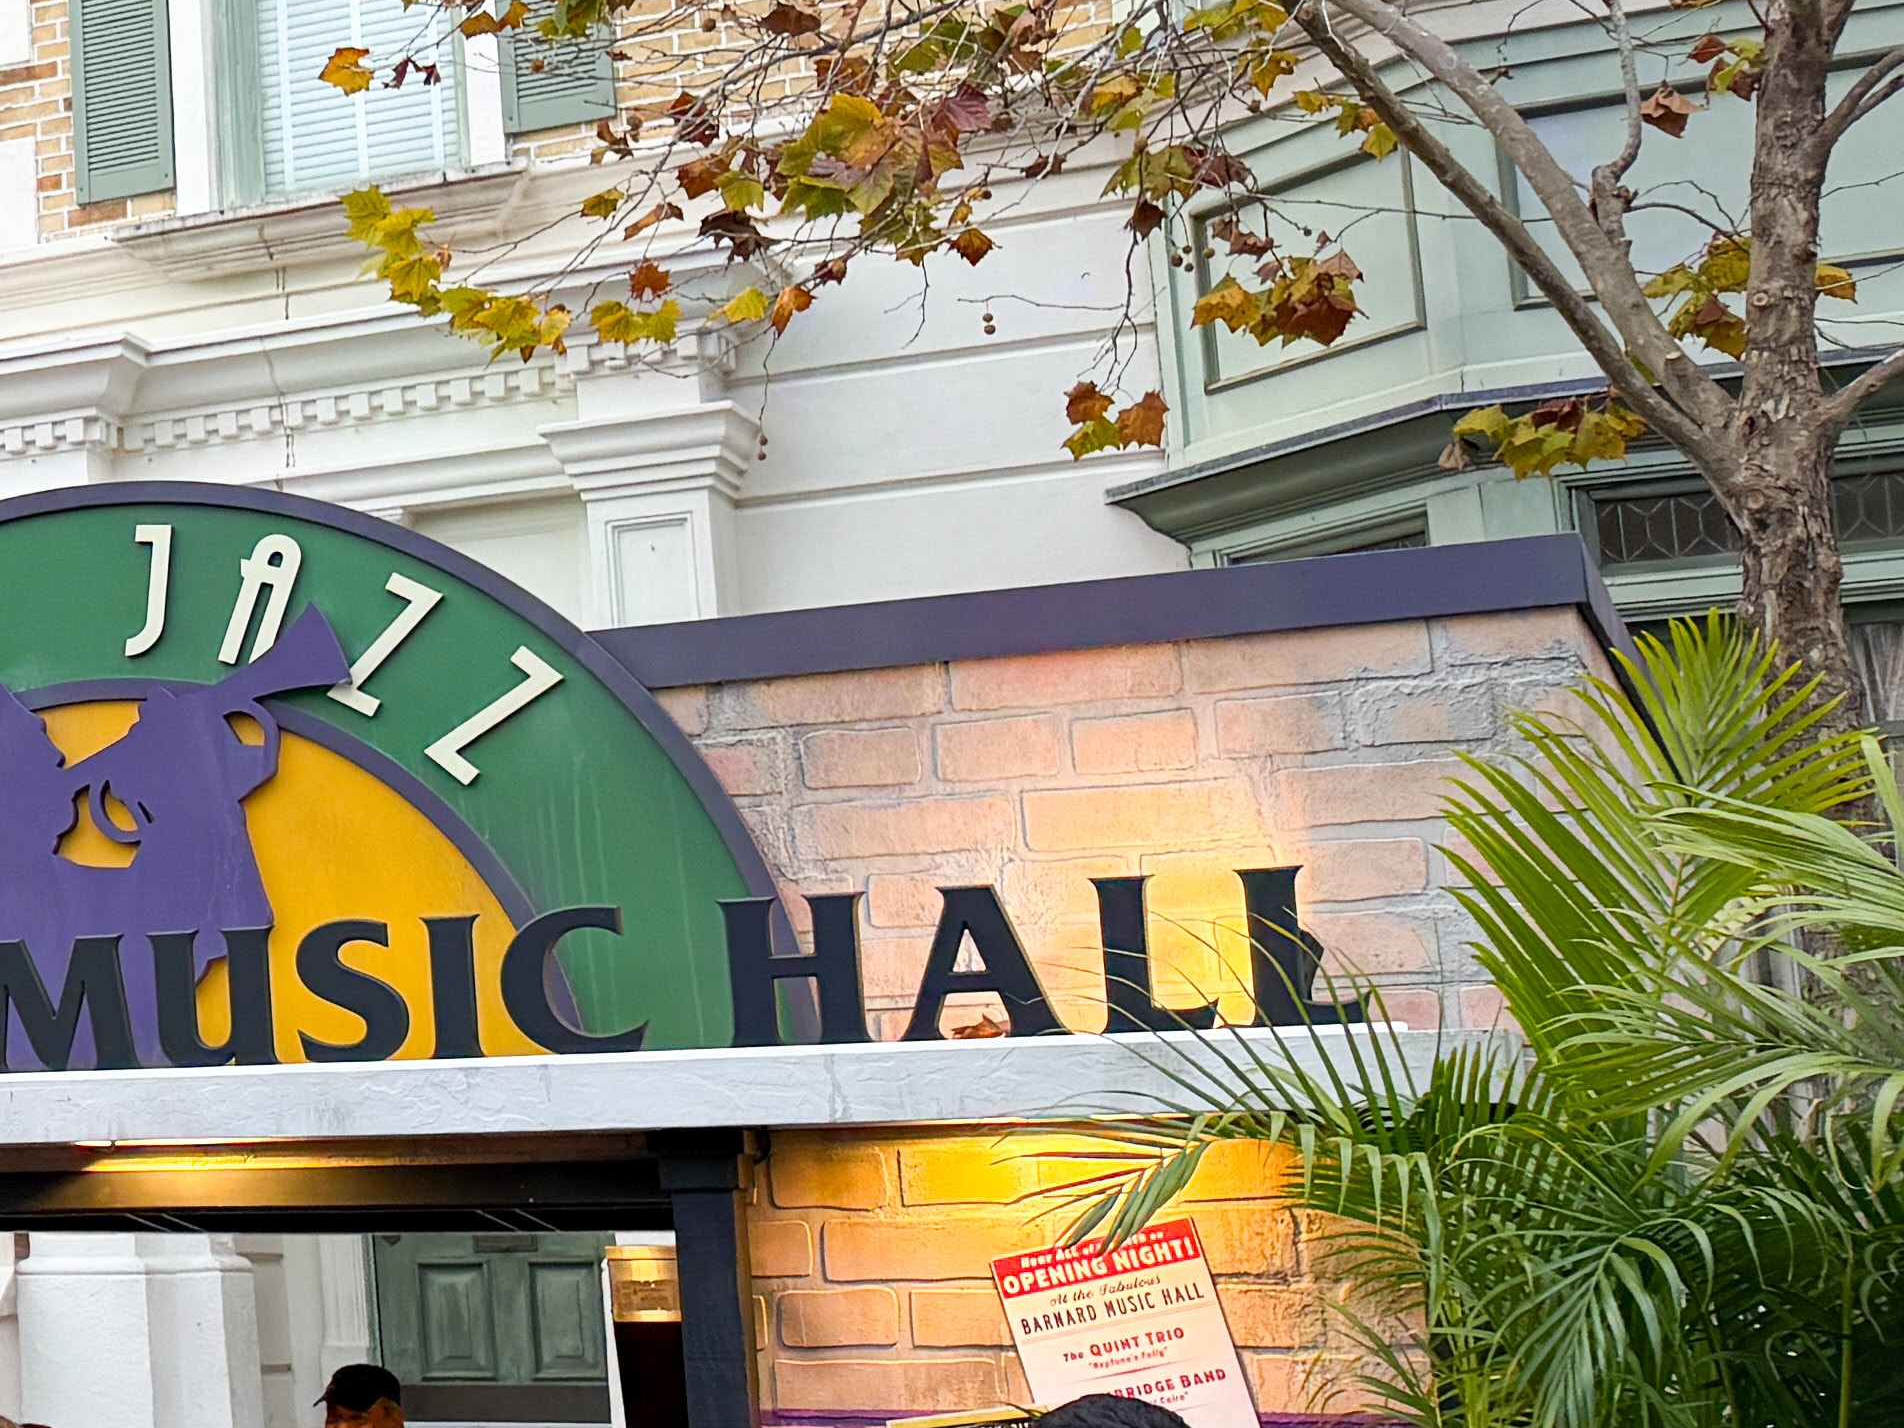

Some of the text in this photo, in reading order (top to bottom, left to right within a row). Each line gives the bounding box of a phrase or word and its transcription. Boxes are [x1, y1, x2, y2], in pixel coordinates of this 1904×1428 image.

[124, 524, 565, 786] JAZZ
[716, 864, 1372, 1048] HALL
[1003, 1255, 1109, 1295] OPENING
[1112, 1236, 1194, 1273] NIGHT!
[1072, 1288, 1094, 1303] the
[1099, 1275, 1162, 1298] Fabulous
[1020, 1281, 1205, 1336] BARNARD MUSIC HALL
[1062, 1326, 1185, 1364] The QUINT TRIO
[1179, 1368, 1227, 1388] BAND
